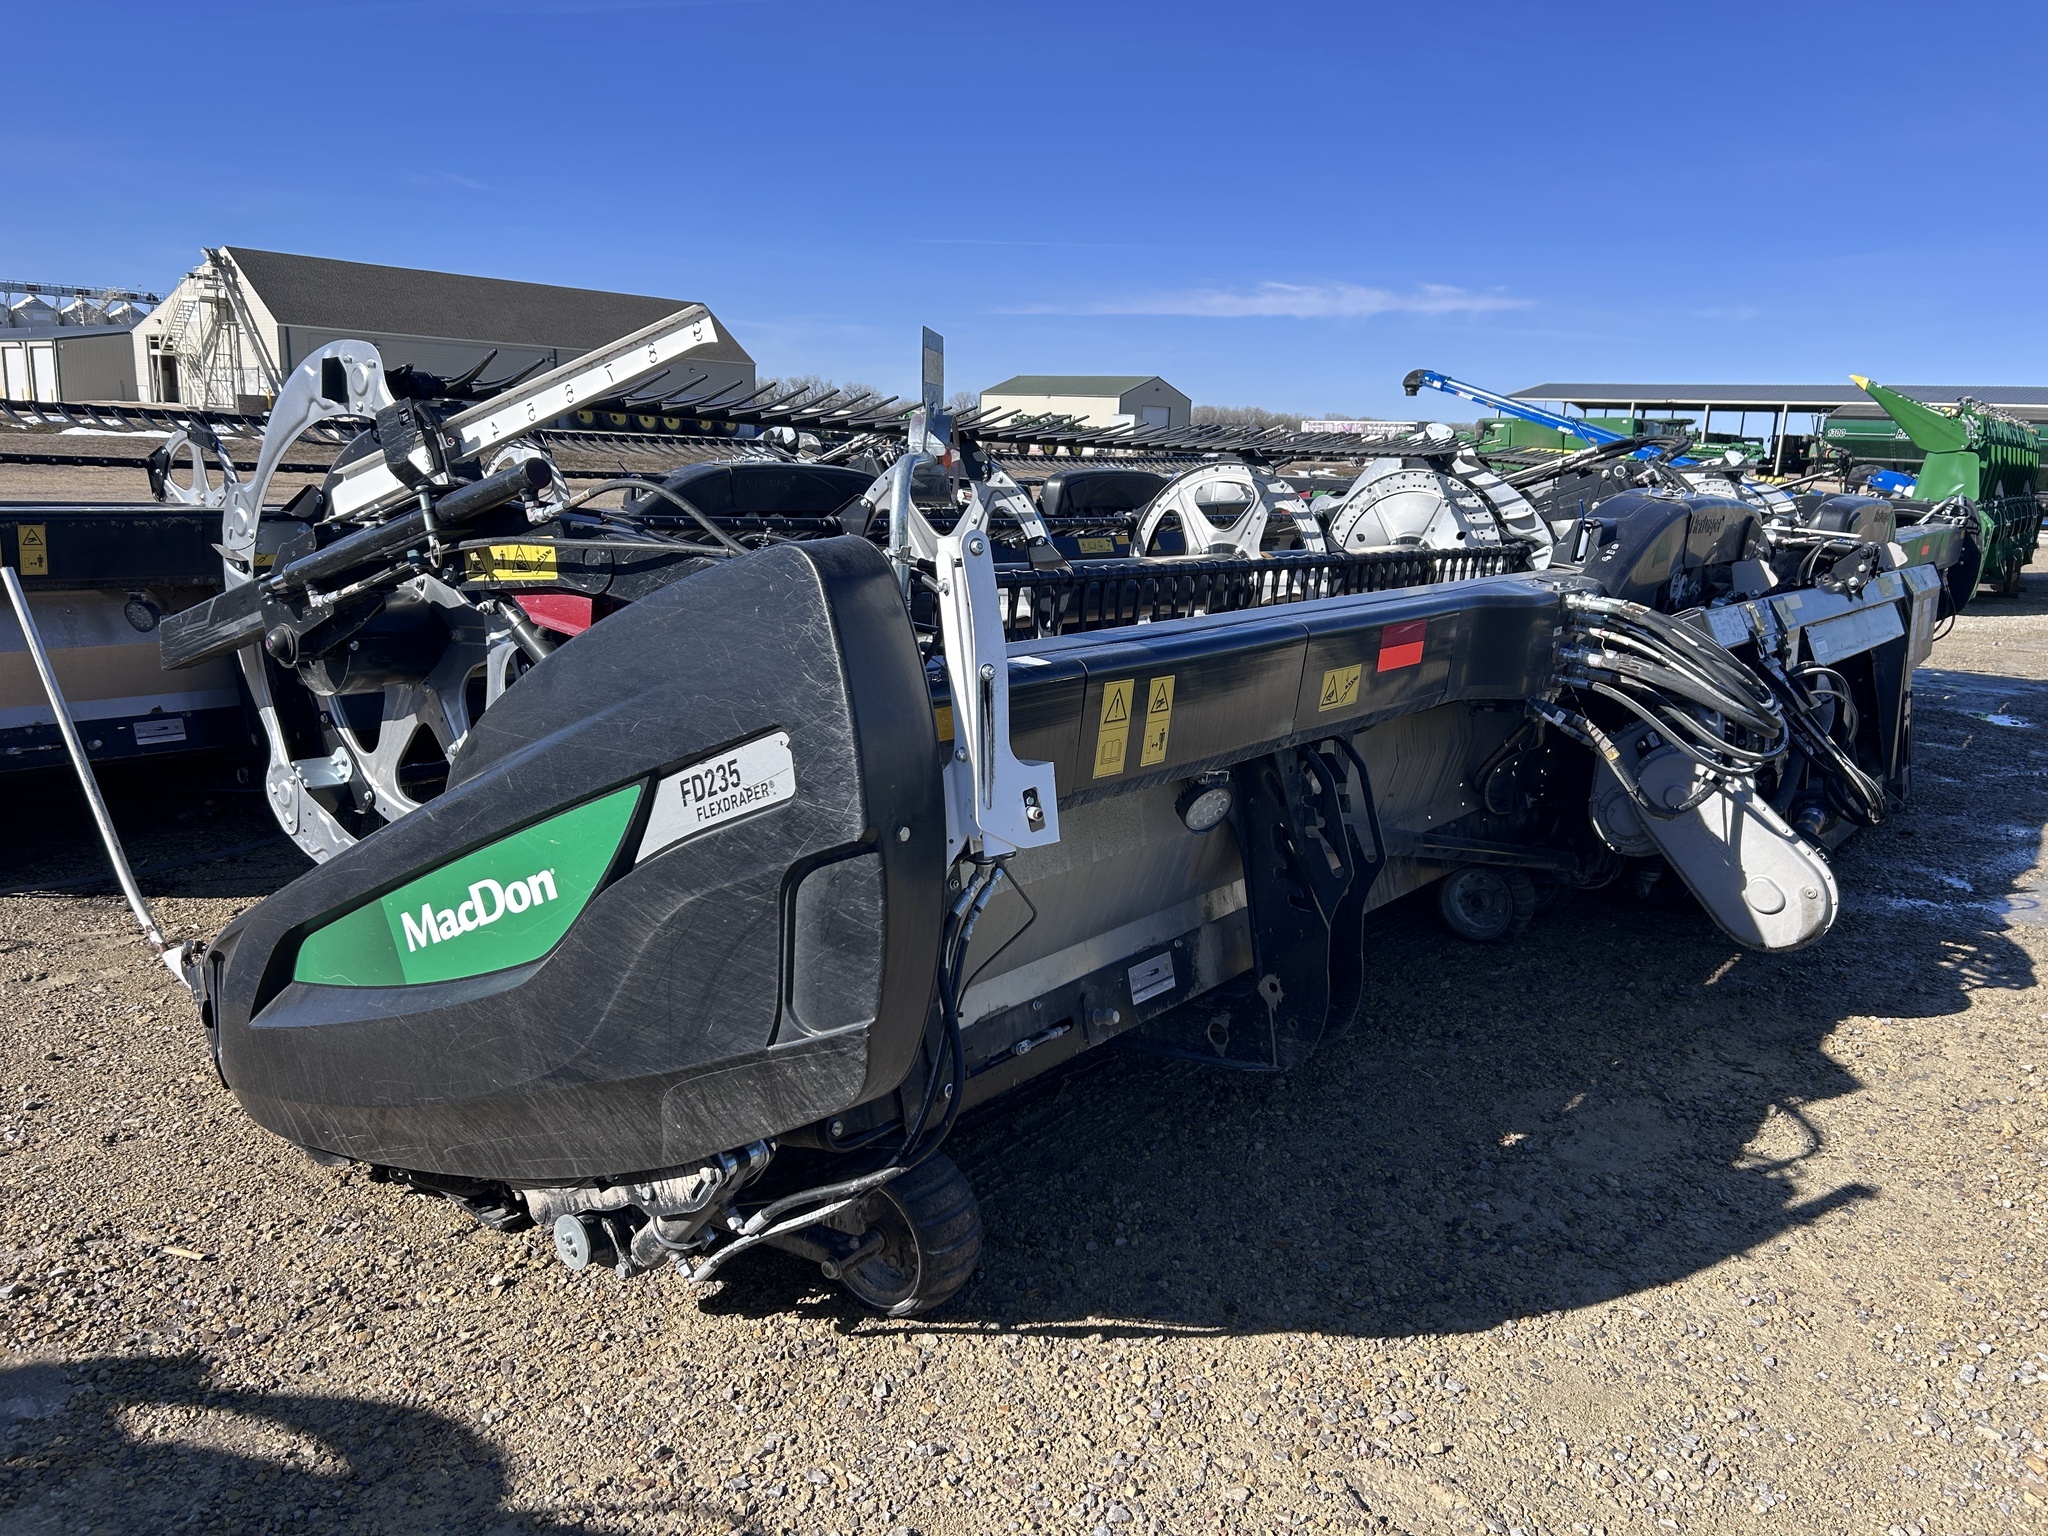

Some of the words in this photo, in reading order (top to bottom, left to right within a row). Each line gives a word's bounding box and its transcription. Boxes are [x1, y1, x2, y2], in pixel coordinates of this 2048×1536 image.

[490, 421, 500, 438] 4
[526, 402, 537, 422] 5
[564, 384, 575, 404] 6
[604, 363, 614, 383] 7
[647, 343, 658, 364] 8
[692, 320, 704, 342] 9
[1827, 428, 1847, 438] 1300
[680, 758, 742, 808] FD235
[400, 869, 559, 953] MacDon
